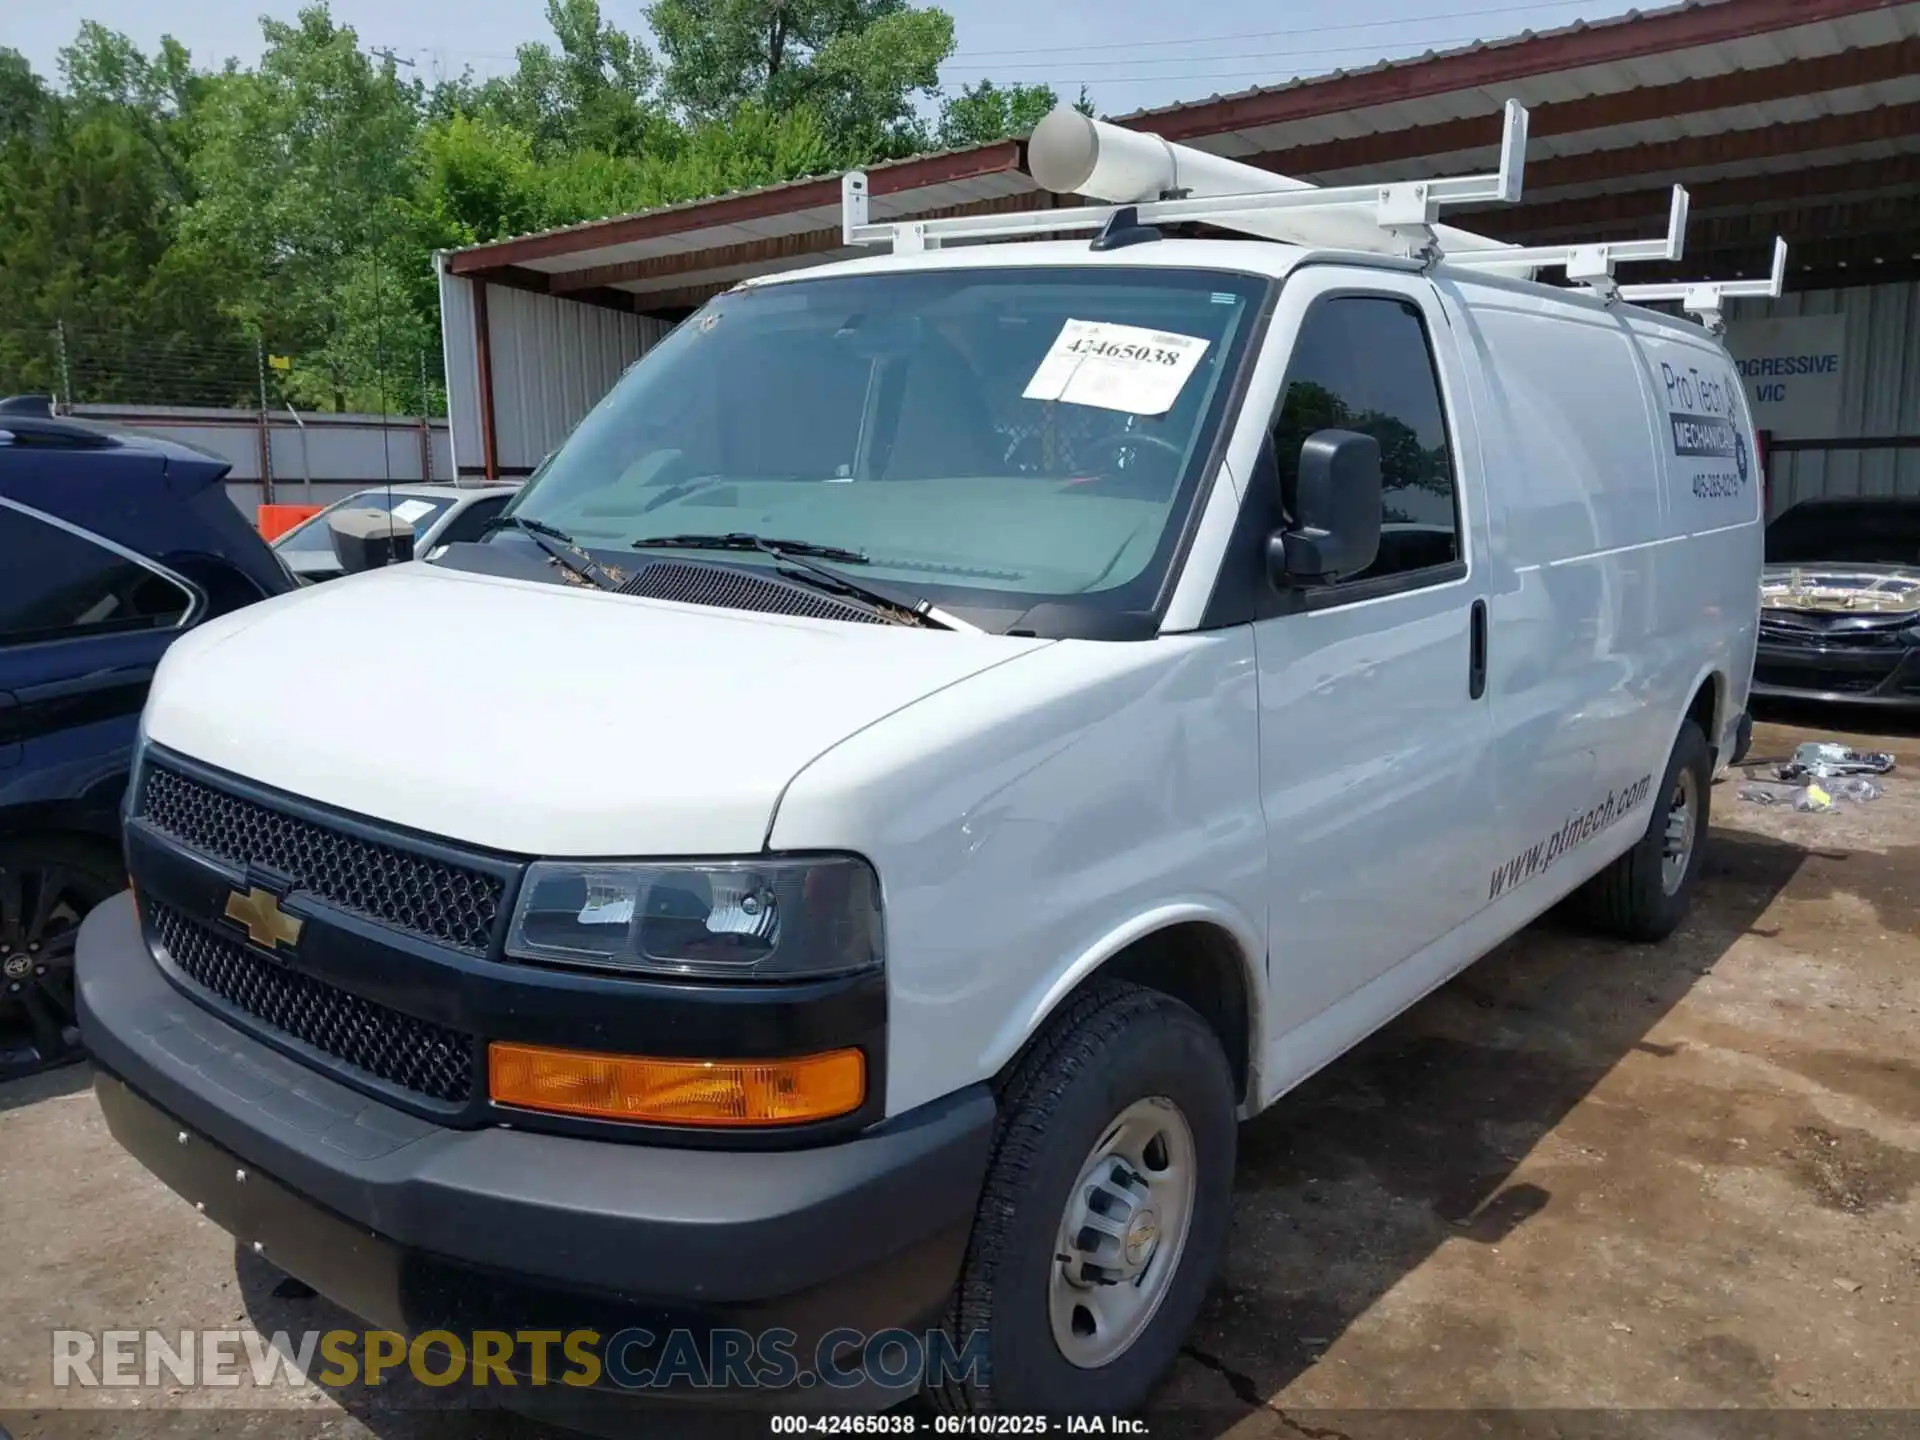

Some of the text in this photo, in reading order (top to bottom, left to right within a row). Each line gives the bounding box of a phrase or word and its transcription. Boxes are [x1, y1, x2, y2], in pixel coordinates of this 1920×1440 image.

[1066, 338, 1181, 367] 42465038
[1660, 362, 1726, 414] Pro Tech
[1756, 383, 1786, 402] VIC
[1673, 421, 1737, 451] MECHANICAL
[1488, 774, 1652, 901] www.ptmech.com
